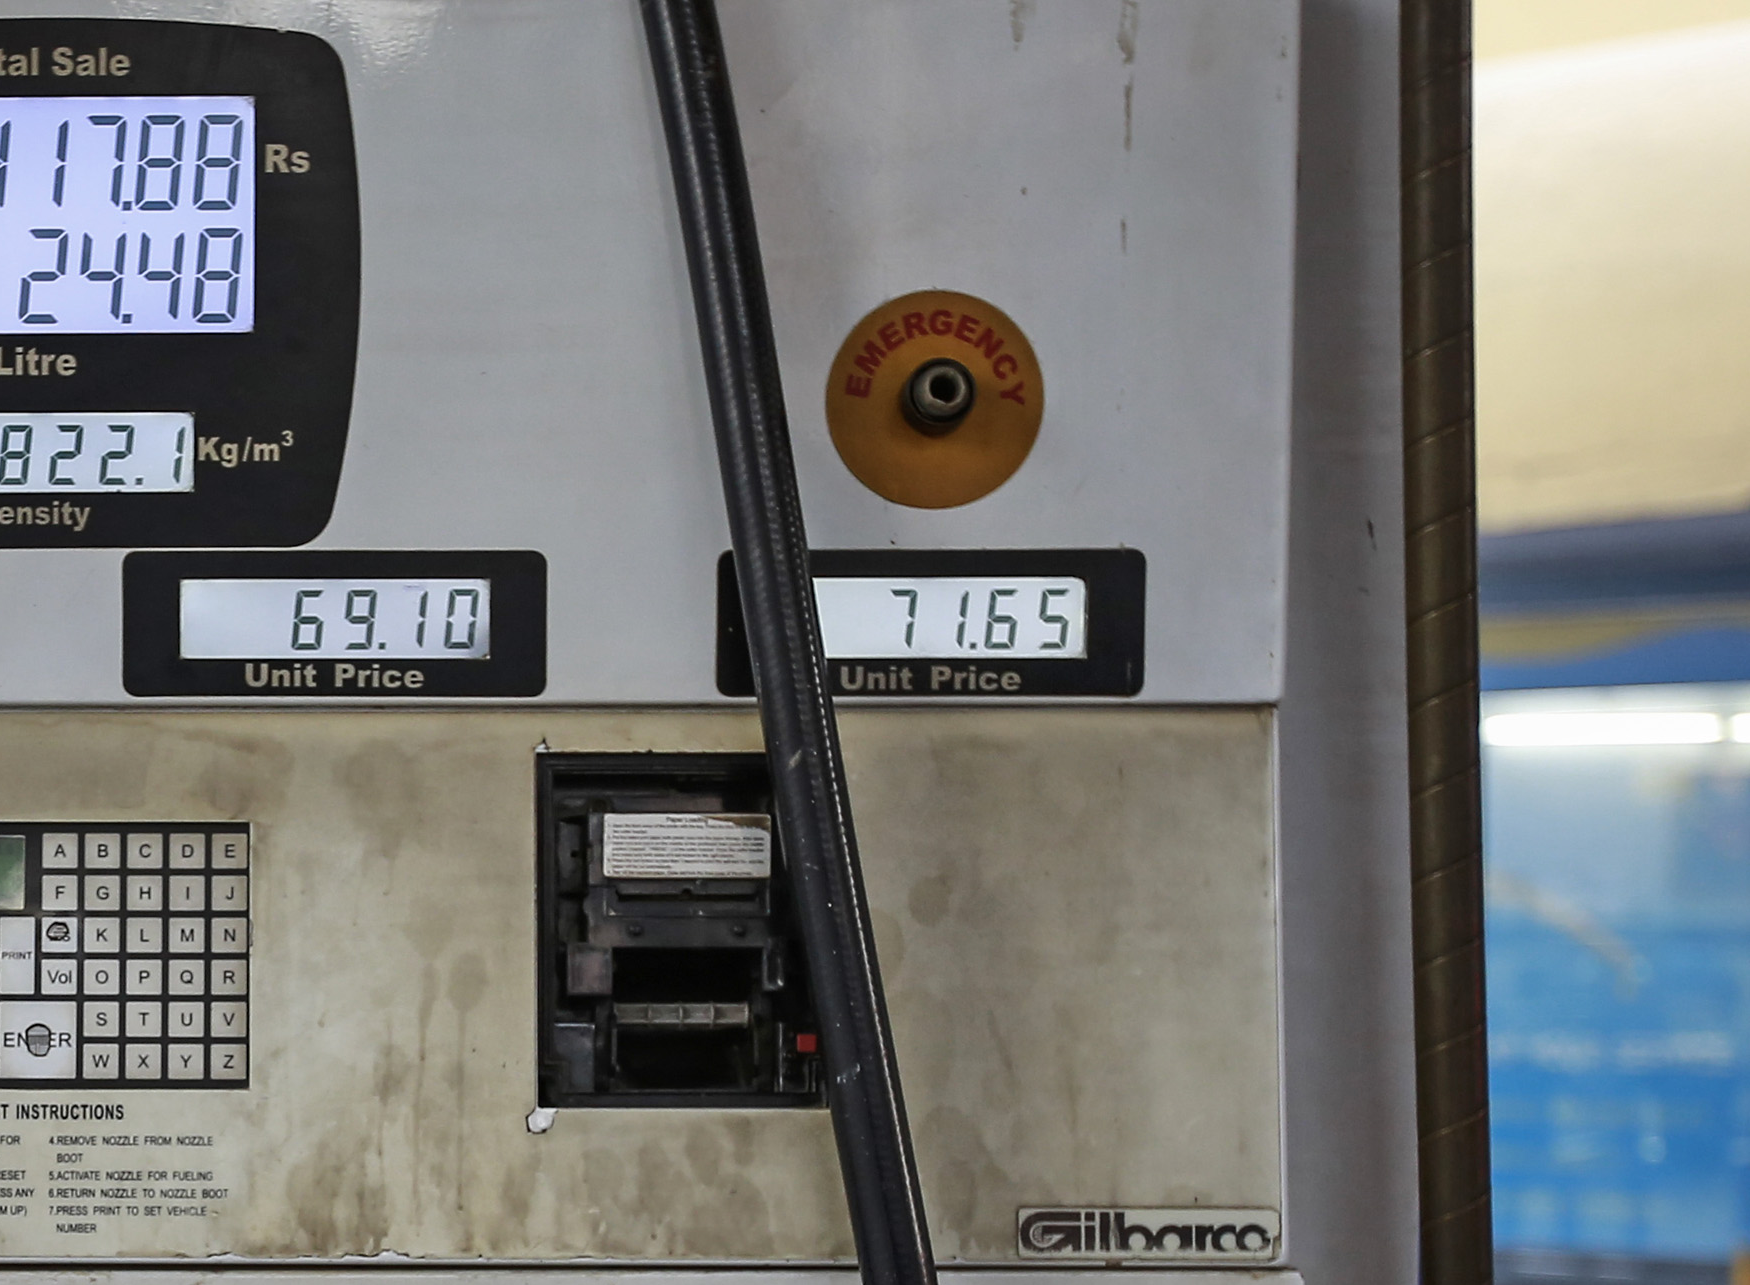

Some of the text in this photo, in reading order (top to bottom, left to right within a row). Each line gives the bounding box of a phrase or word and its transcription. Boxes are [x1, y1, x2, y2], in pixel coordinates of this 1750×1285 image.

[51, 46, 131, 76] Sale
[264, 144, 310, 174] Rs
[18, 227, 244, 324] 24.48
[845, 309, 1025, 405] EMERGENCY
[291, 589, 480, 650] 69.10
[891, 588, 1070, 650] 71.65
[244, 663, 425, 688] Unit Price
[840, 666, 1022, 691] Unit Price
[54, 844, 236, 858] A B C D E
[55, 886, 66, 899] F
[96, 886, 110, 900] G
[139, 886, 151, 900] H
[225, 886, 234, 900] J
[96, 928, 236, 942] K L M N
[1, 951, 33, 960] PRINT
[47, 970, 235, 985] Vol O P Q R
[96, 1012, 235, 1026] S T U V
[3, 1032, 72, 1048] ENER
[92, 1055, 235, 1069] W X Y Z
[16, 1104, 124, 1120] INSTRUCTIONS
[0, 1135, 20, 1145] FOR
[102, 1136, 139, 1146] NOZZLE
[144, 1136, 172, 1146] FROM
[176, 1136, 213, 1146] NOZZLE
[56, 1153, 83, 1163] BOOT
[106, 1171, 142, 1181] NOZZLE
[148, 1171, 168, 1181] FOR
[172, 1171, 213, 1181] FUELING
[15, 1188, 34, 1198] ANY
[100, 1189, 137, 1199] NOZZLE
[142, 1189, 155, 1199] TO
[160, 1189, 197, 1199] NOZZLE
[202, 1189, 229, 1199] BOOT
[10, 1205, 27, 1215] UP)
[93, 1206, 121, 1216] PRINT
[126, 1206, 139, 1216] TO
[144, 1206, 162, 1216] SET
[167, 1206, 208, 1216] VEHICLE
[56, 1223, 97, 1233] NUMBER
[1020, 1211, 1270, 1251] Gilbarco
